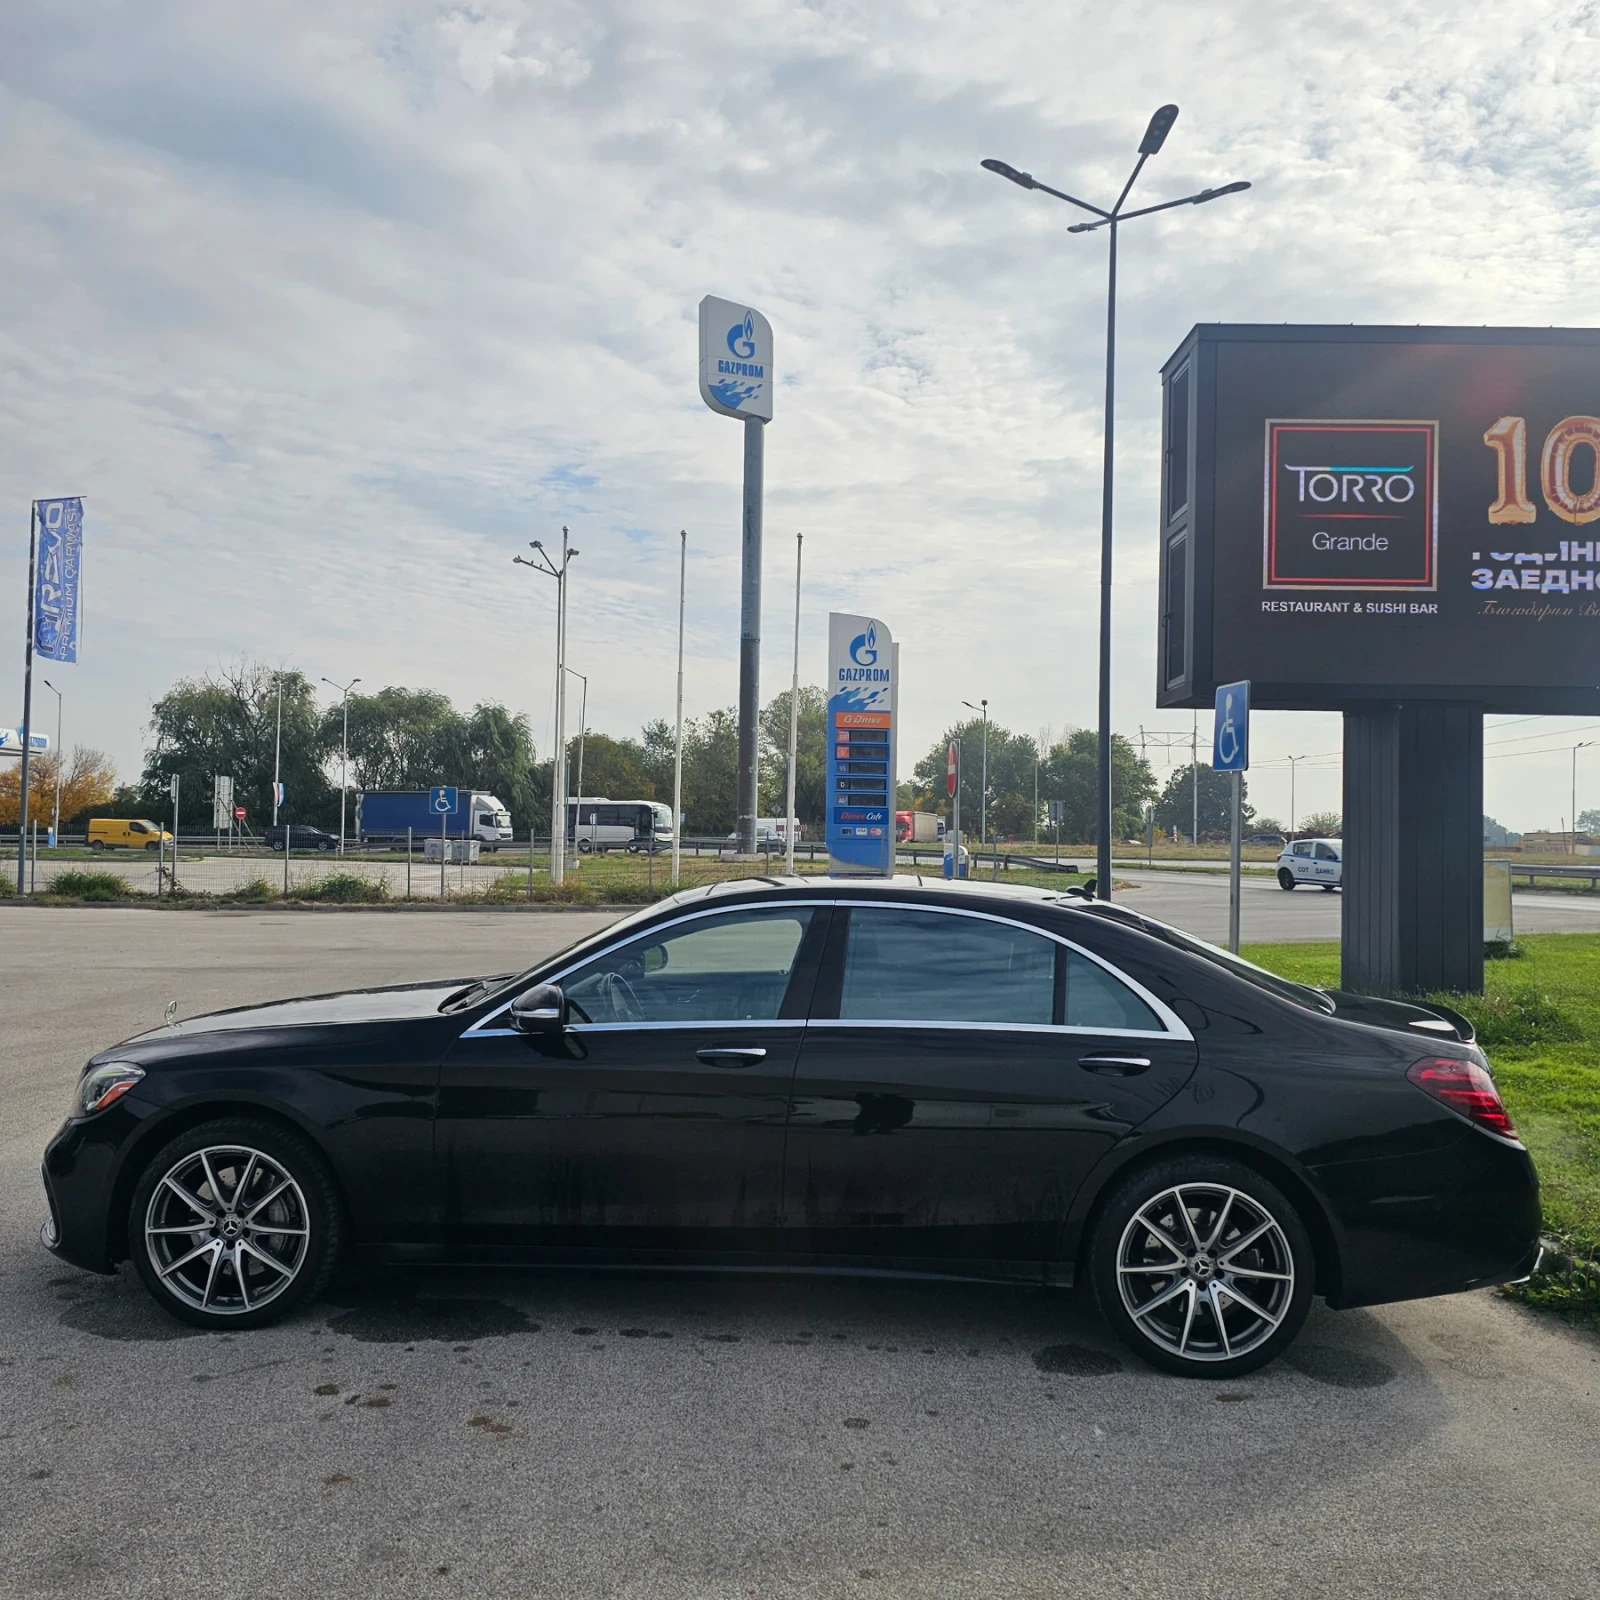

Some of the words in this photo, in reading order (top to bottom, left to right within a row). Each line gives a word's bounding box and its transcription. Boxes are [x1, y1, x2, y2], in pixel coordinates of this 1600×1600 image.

[718, 360, 764, 379] GAZPROM
[1483, 415, 1600, 525] 10
[1284, 464, 1415, 503] TORRO
[1312, 531, 1389, 551] Grande
[1470, 568, 1600, 595] ЗАЕДН
[1261, 601, 1350, 613] RESTAURANT
[1353, 602, 1363, 613] &
[1366, 603, 1407, 614] SUSHI
[1410, 603, 1438, 614] BAR
[59, 582, 74, 659] PREMIUM
[838, 668, 890, 683] GAZPROM
